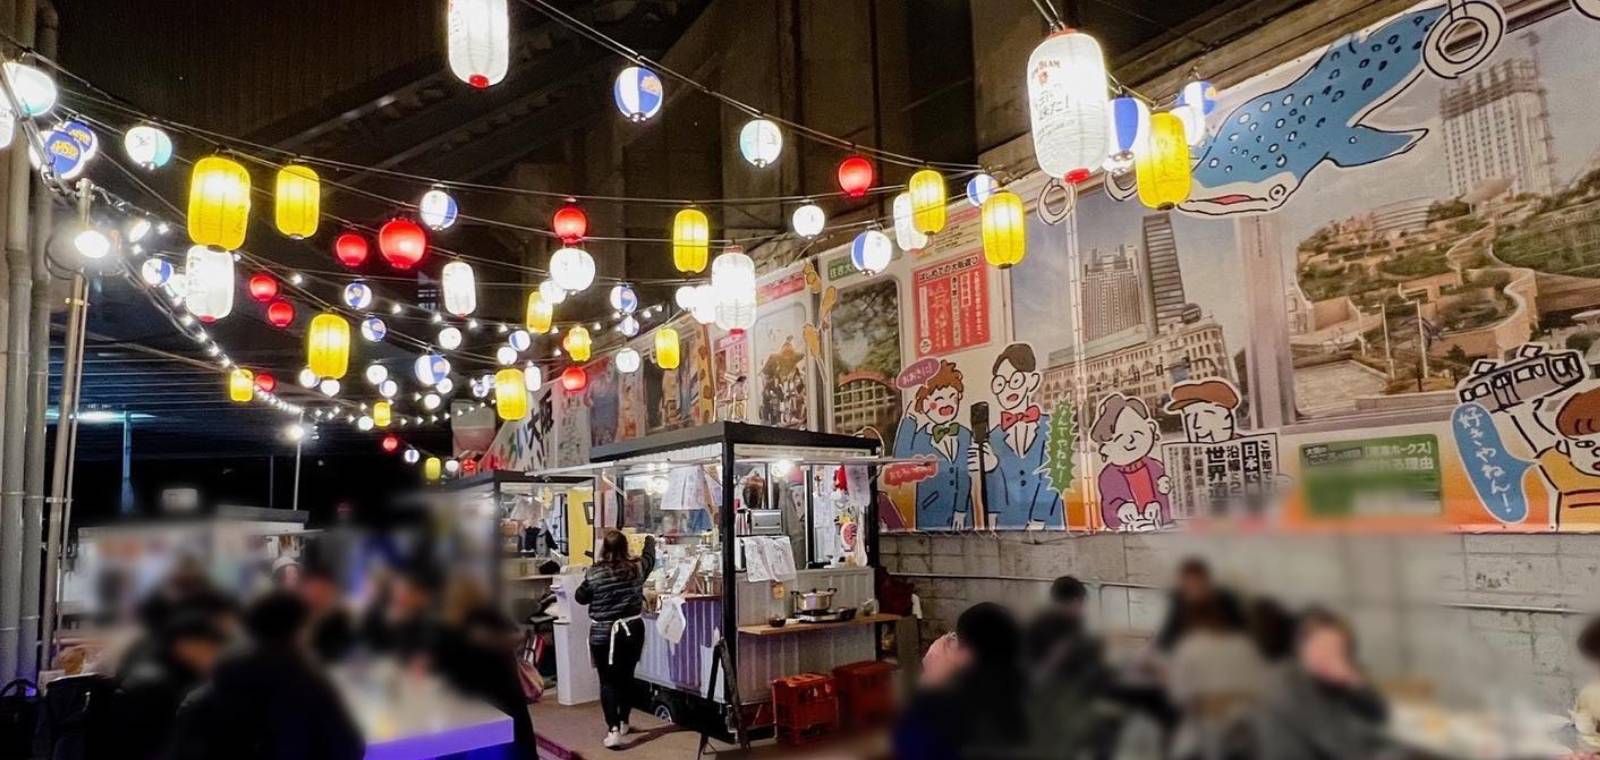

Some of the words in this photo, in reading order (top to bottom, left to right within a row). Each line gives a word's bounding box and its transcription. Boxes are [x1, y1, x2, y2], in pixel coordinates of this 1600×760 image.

[1459, 406, 1512, 514] 好きやねん!
